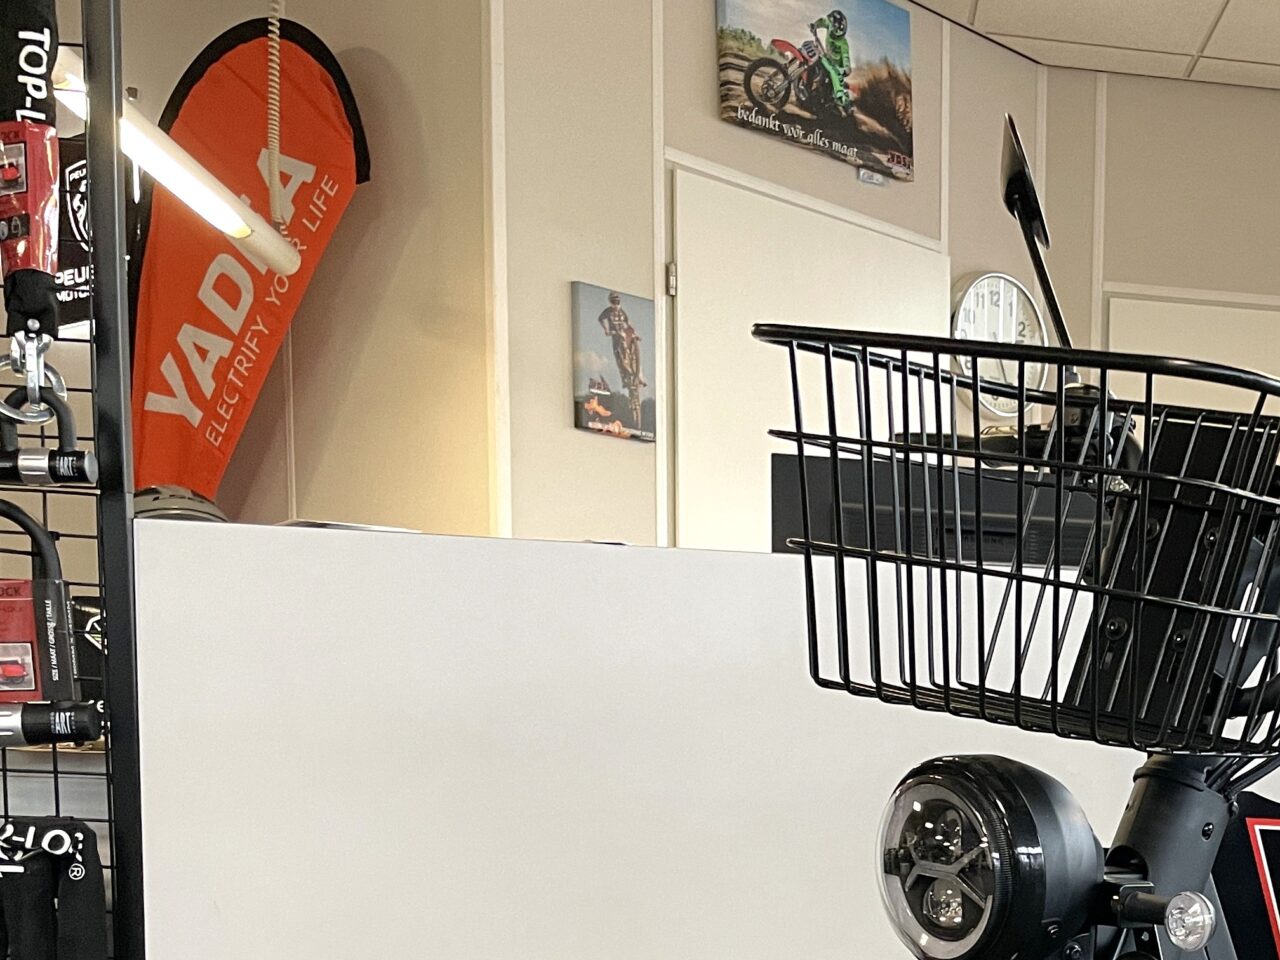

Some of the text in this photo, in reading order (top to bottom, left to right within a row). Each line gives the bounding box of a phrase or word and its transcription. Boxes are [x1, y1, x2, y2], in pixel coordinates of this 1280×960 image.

[738, 104, 781, 132] bedankt
[807, 129, 830, 147] alles
[832, 141, 858, 158] maat
[144, 148, 317, 428] YADA
[205, 315, 270, 448] ELECTRIFY
[302, 174, 339, 232] LIFE
[1017, 320, 1027, 338] 2
